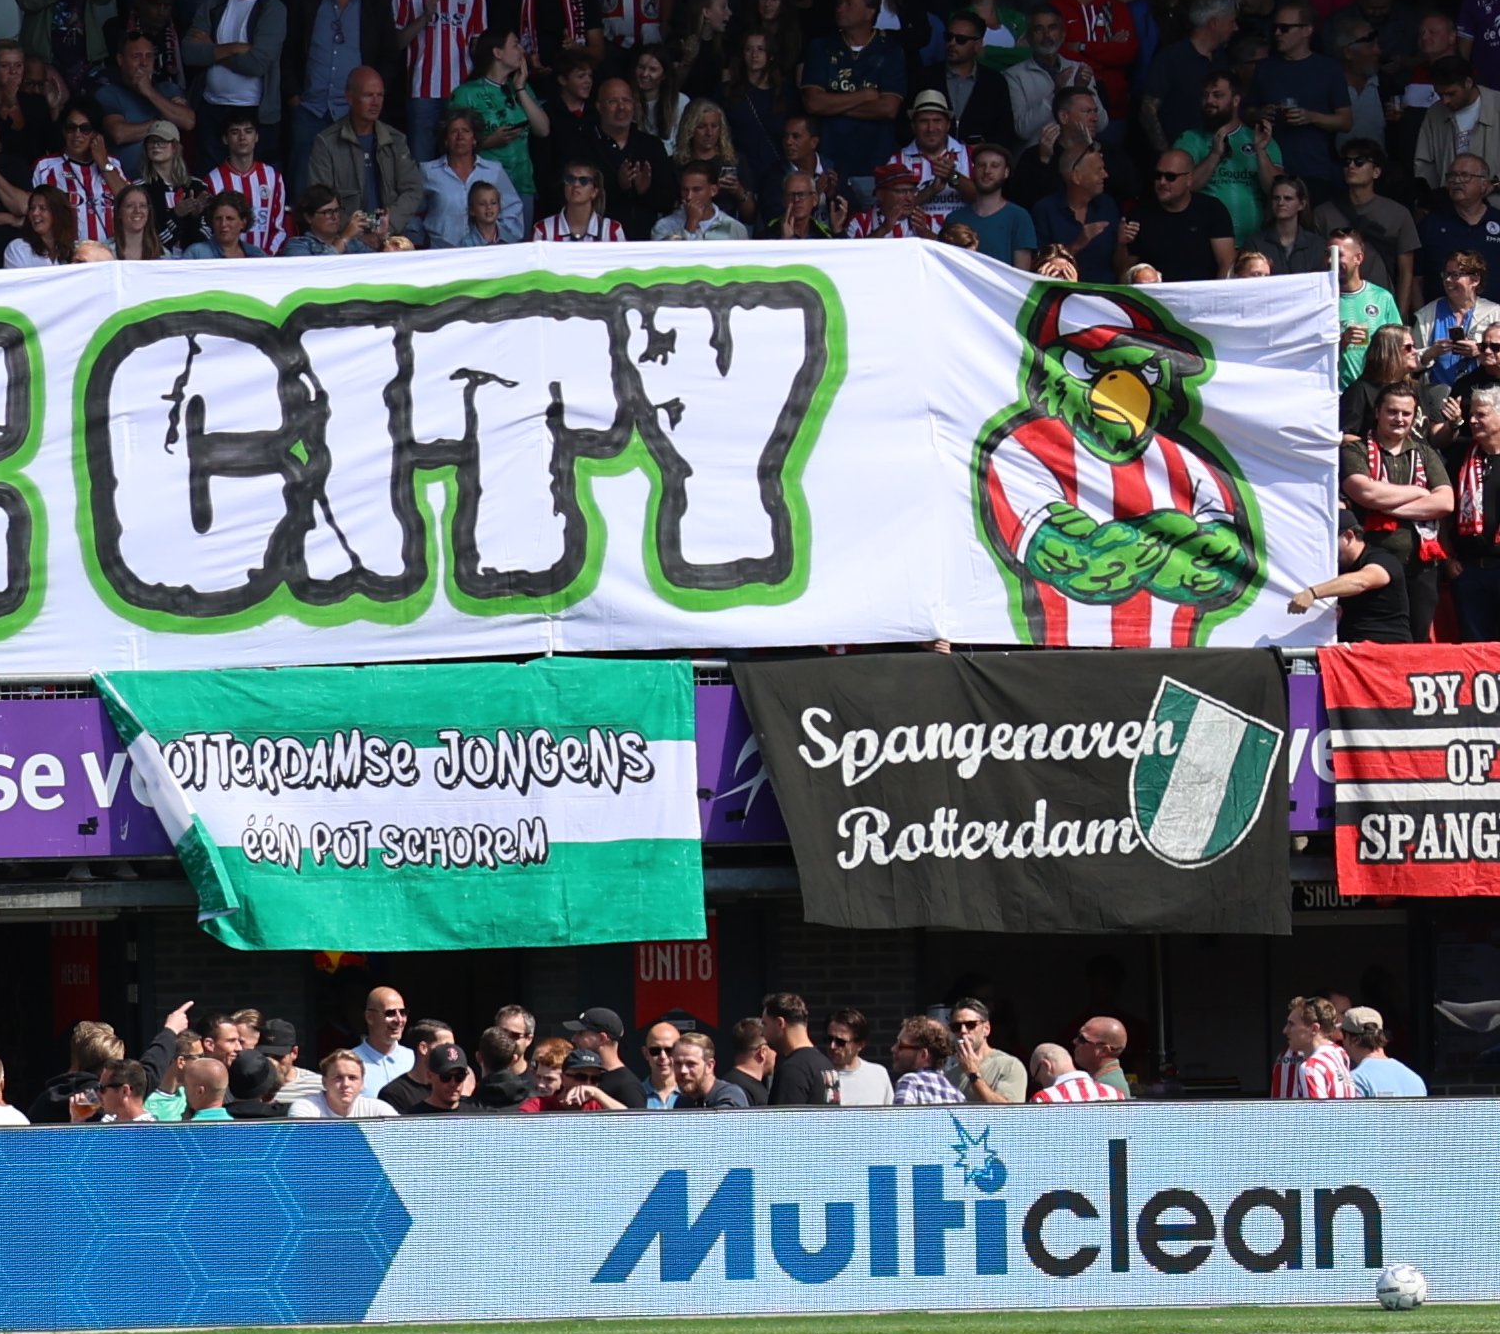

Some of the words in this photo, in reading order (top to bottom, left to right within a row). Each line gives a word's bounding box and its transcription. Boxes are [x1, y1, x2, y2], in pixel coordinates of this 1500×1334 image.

[1409, 675, 1462, 716] BY
[799, 707, 1181, 787] Spangenaren
[1447, 743, 1494, 784] OF
[836, 798, 1143, 871] Rotterdam
